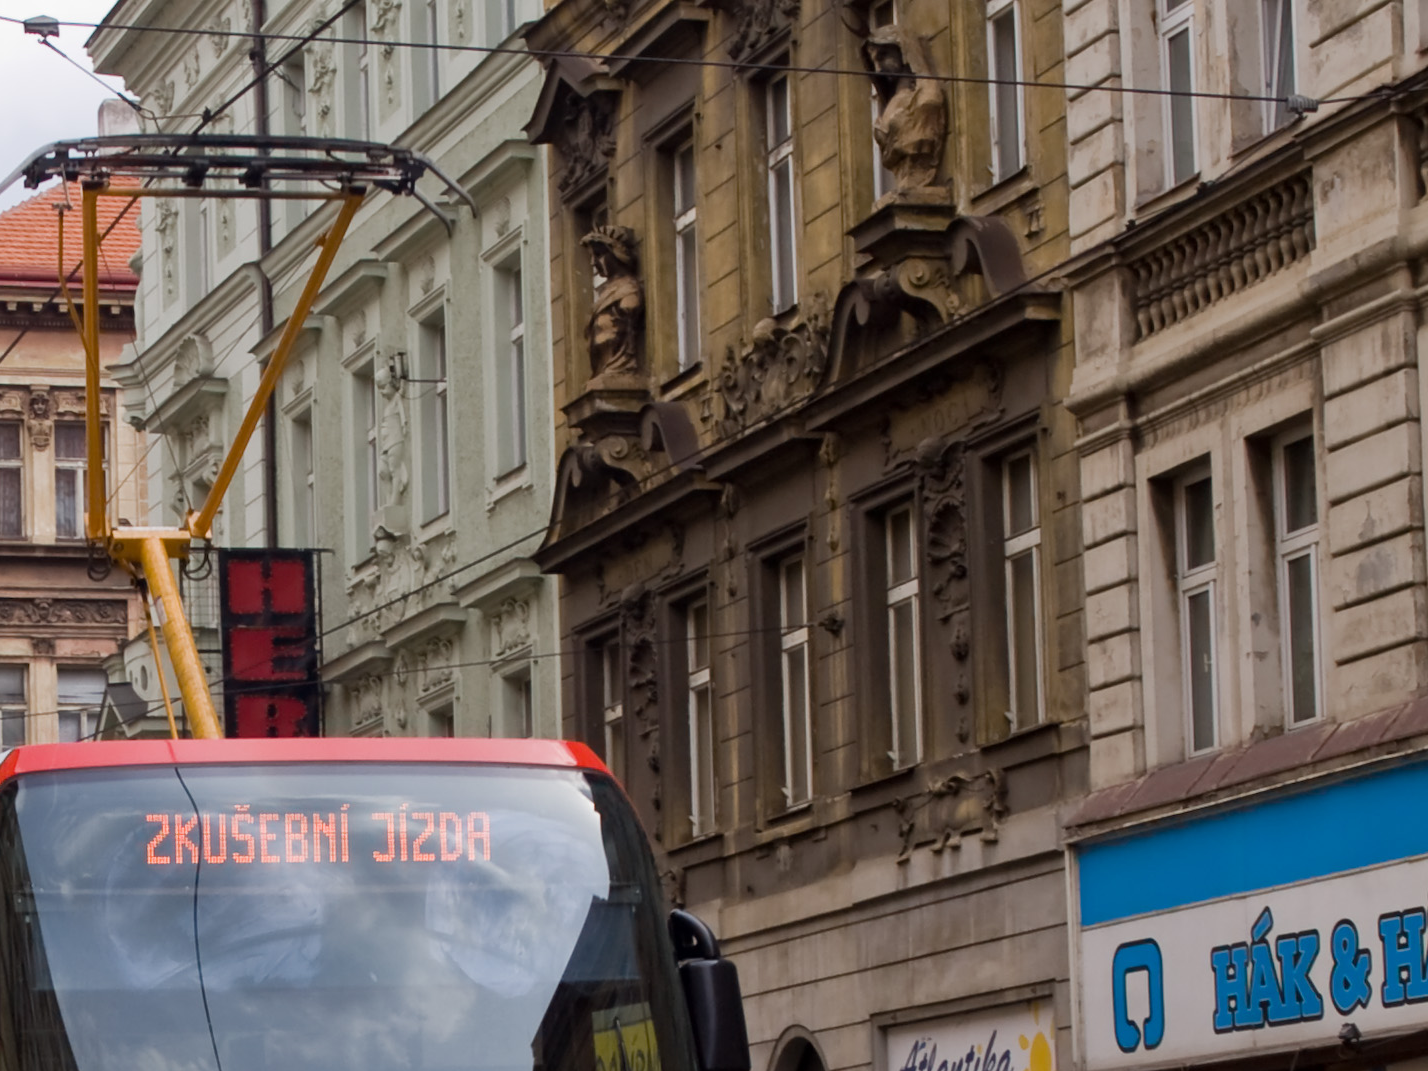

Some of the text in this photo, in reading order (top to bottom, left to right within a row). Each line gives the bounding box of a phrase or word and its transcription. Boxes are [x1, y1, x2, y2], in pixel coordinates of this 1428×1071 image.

[146, 803, 491, 864] ZKUŠEBNÍ JÍZDA
[1211, 906, 1428, 1034] HÁK & H
